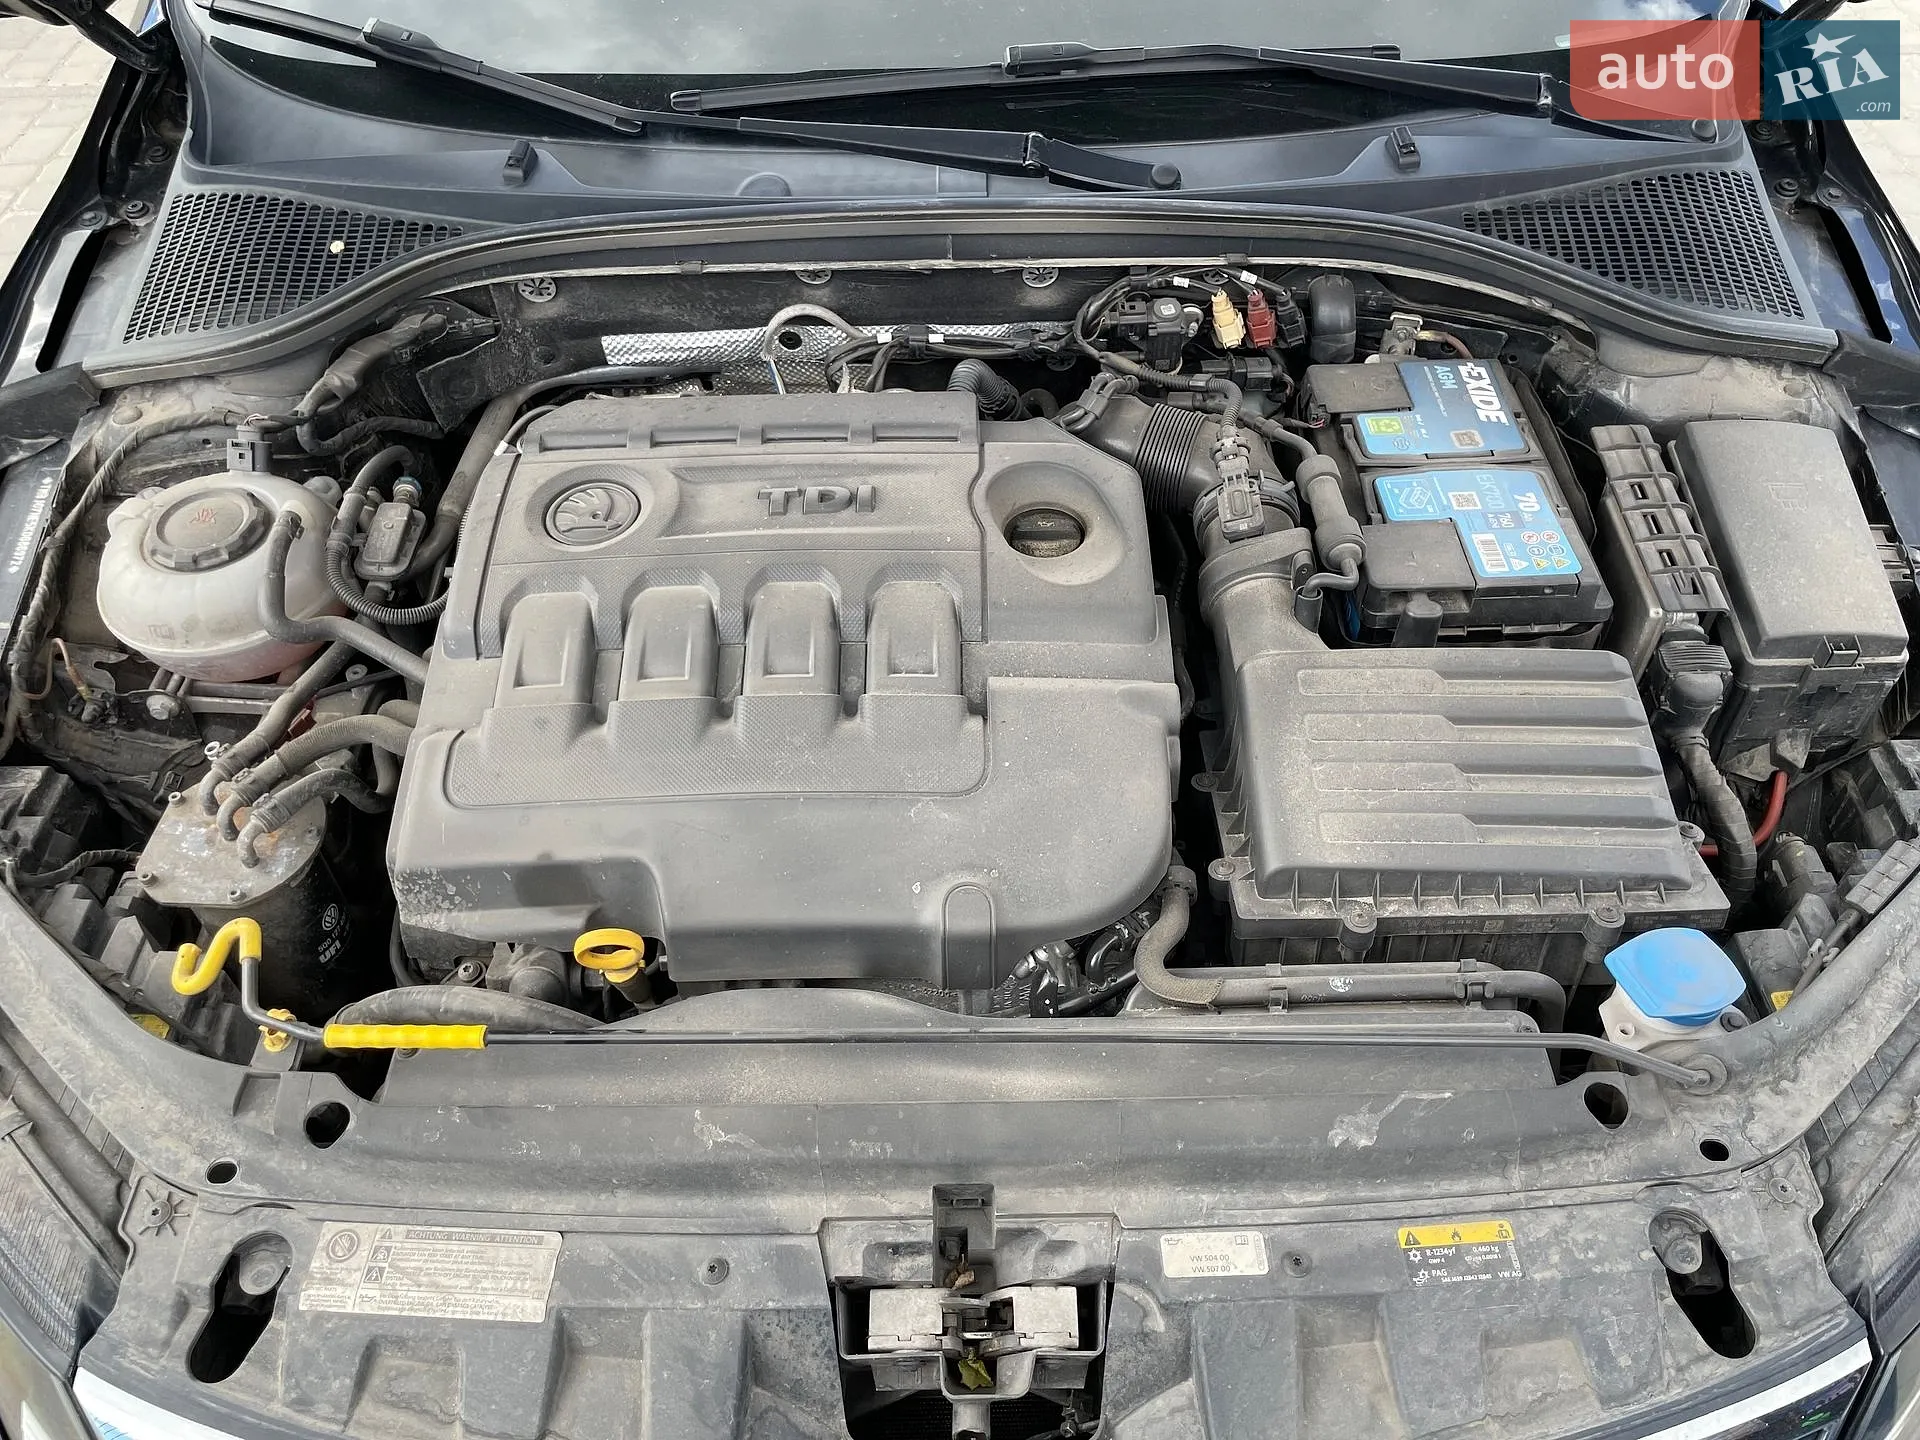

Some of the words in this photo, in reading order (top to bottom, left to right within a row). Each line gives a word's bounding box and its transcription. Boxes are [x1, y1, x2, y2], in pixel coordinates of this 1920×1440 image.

[1434, 365, 1459, 389] AGM
[1457, 362, 1510, 426] EXIDE
[757, 484, 876, 516] TDI
[1513, 492, 1541, 512] 70
[1497, 513, 1515, 528] 760
[319, 939, 342, 964] UFI
[407, 1230, 449, 1241] ACHTUNG
[452, 1231, 490, 1242] WARNING
[494, 1233, 539, 1244] ATTENTION
[1206, 1265, 1219, 1273] 507
[1220, 1265, 1231, 1273] 00
[1431, 1268, 1448, 1277] PAG
